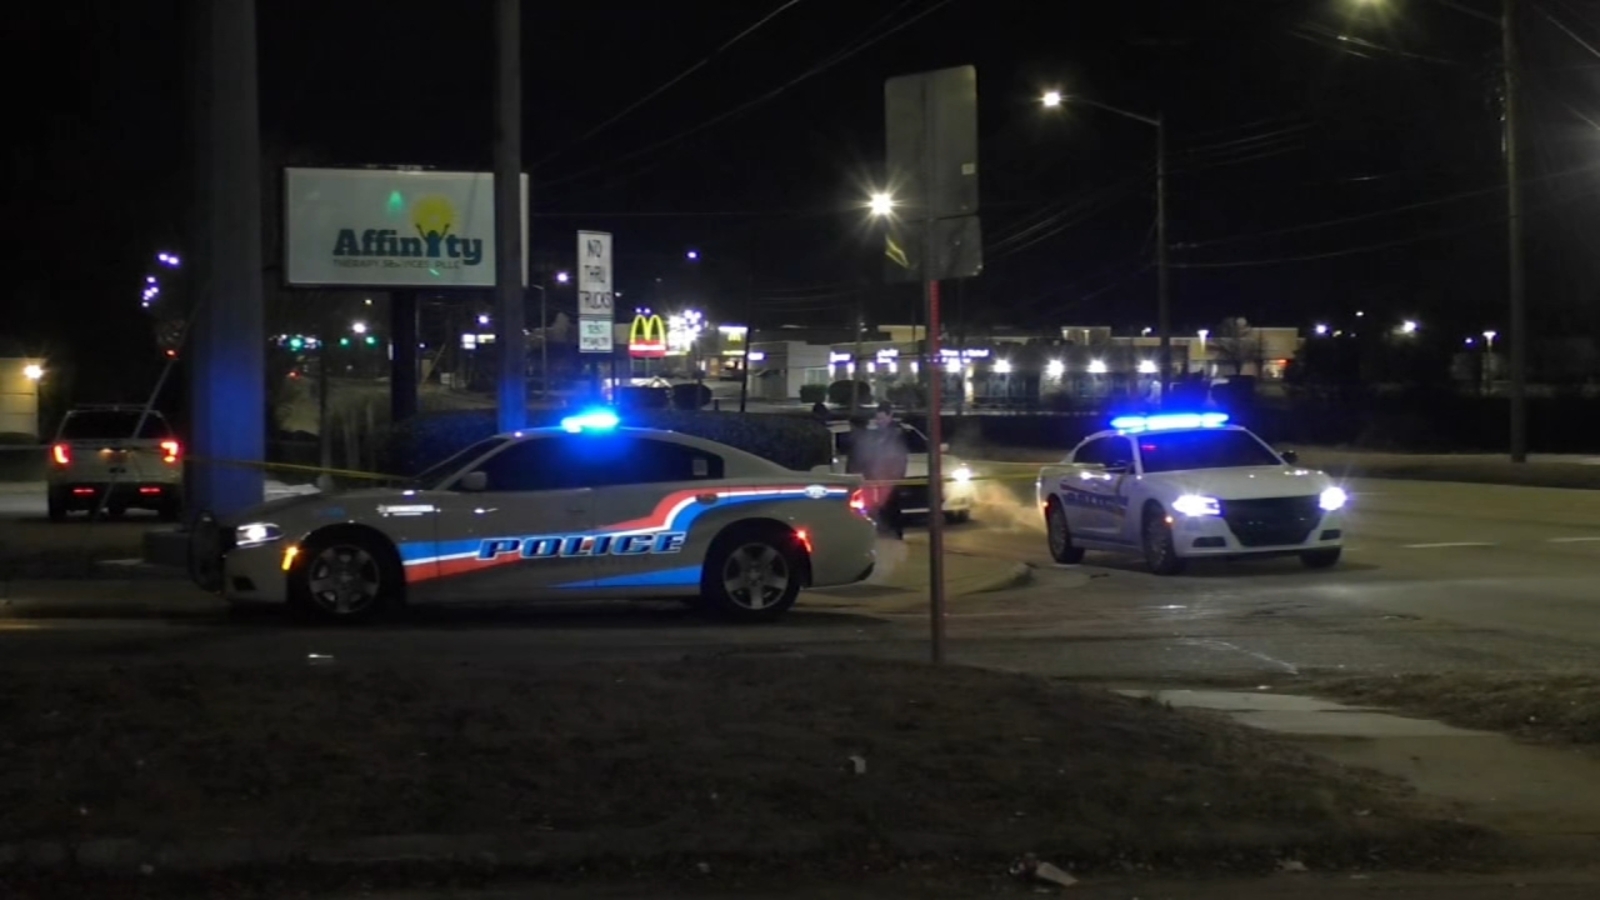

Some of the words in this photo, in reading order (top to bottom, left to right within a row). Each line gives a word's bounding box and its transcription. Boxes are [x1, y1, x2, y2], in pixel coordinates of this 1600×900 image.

[333, 228, 483, 266] Affinity
[587, 239, 602, 258] NO
[584, 265, 606, 283] THRU
[580, 291, 612, 309] TRUCKS
[475, 531, 687, 561] POLICE
